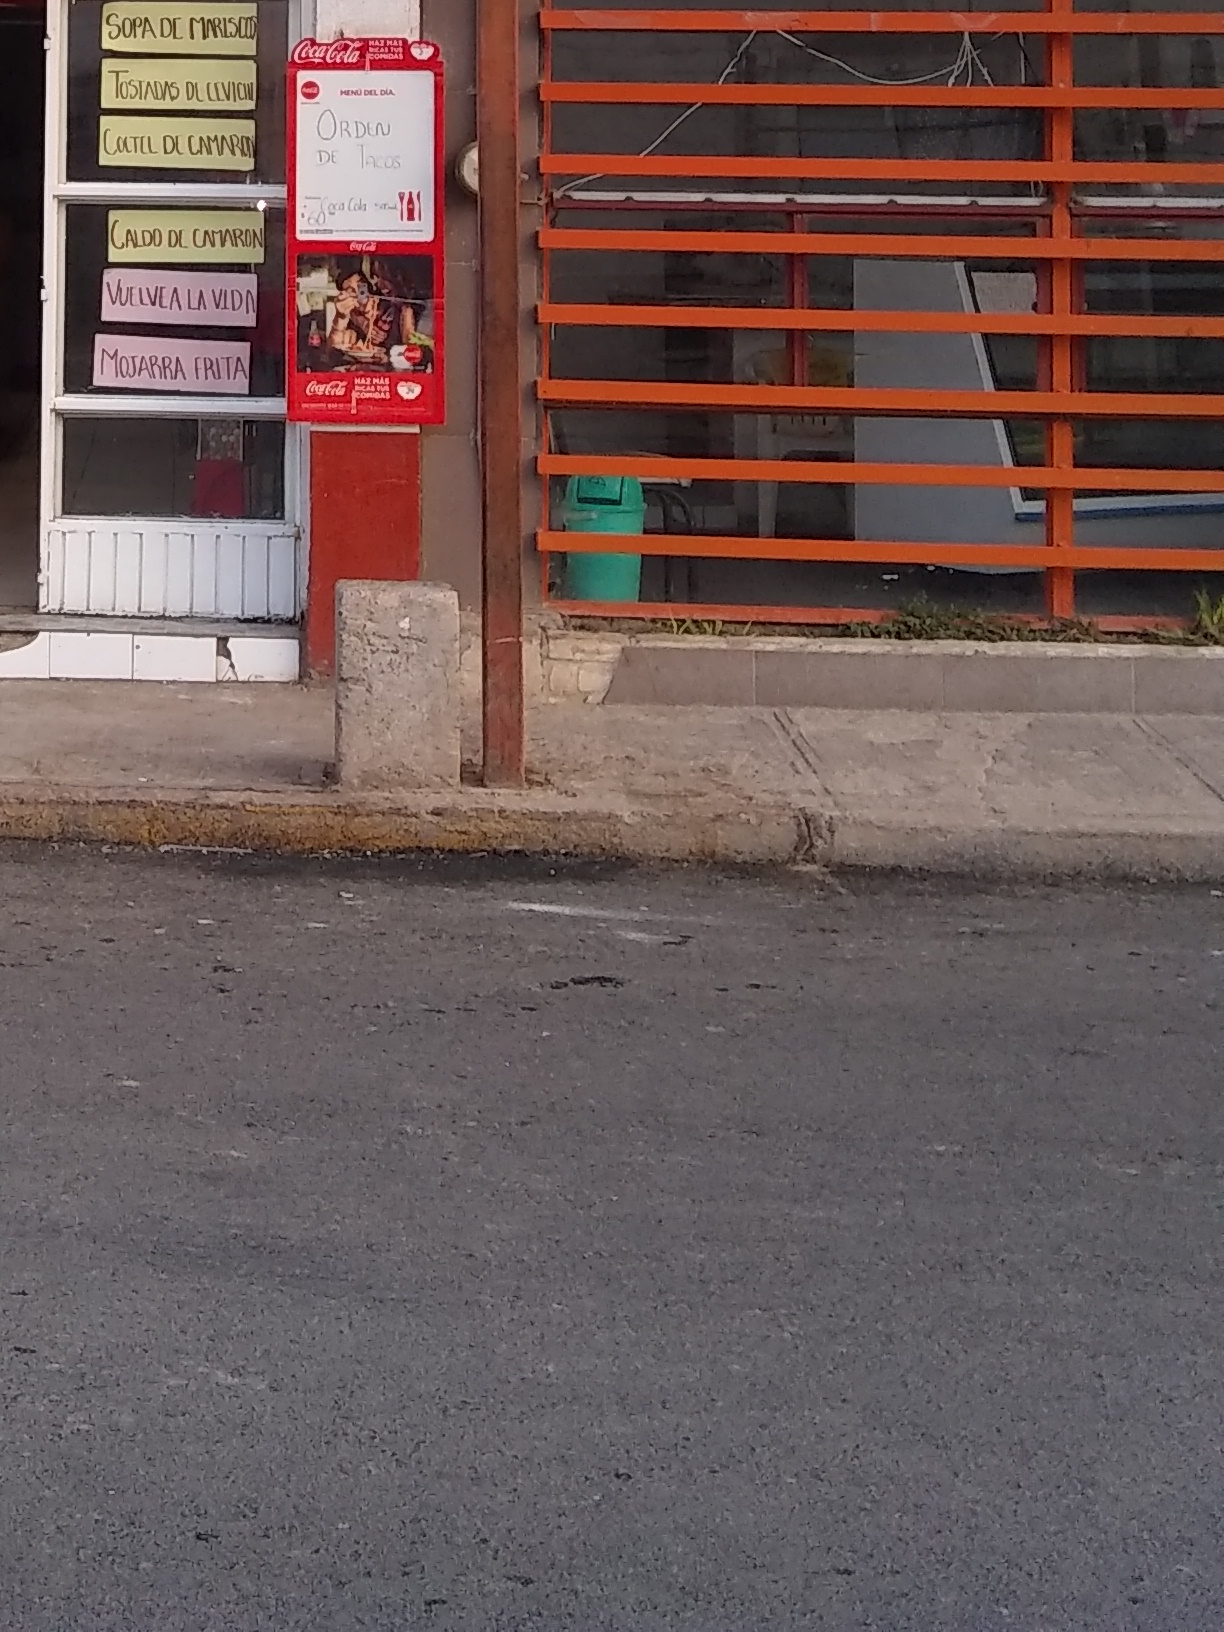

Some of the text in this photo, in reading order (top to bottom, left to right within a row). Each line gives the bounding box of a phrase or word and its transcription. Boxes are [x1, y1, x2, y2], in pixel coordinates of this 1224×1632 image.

[105, 12, 157, 41] SOPA
[160, 16, 184, 40] DE
[107, 69, 180, 102] TOSTADAS
[363, 89, 378, 97] DEL
[110, 219, 163, 249] CALDO
[192, 227, 264, 249] CAMARON
[187, 288, 207, 311] LA
[211, 288, 256, 315] VIDA
[100, 347, 248, 381] MOJARRA FRITA
